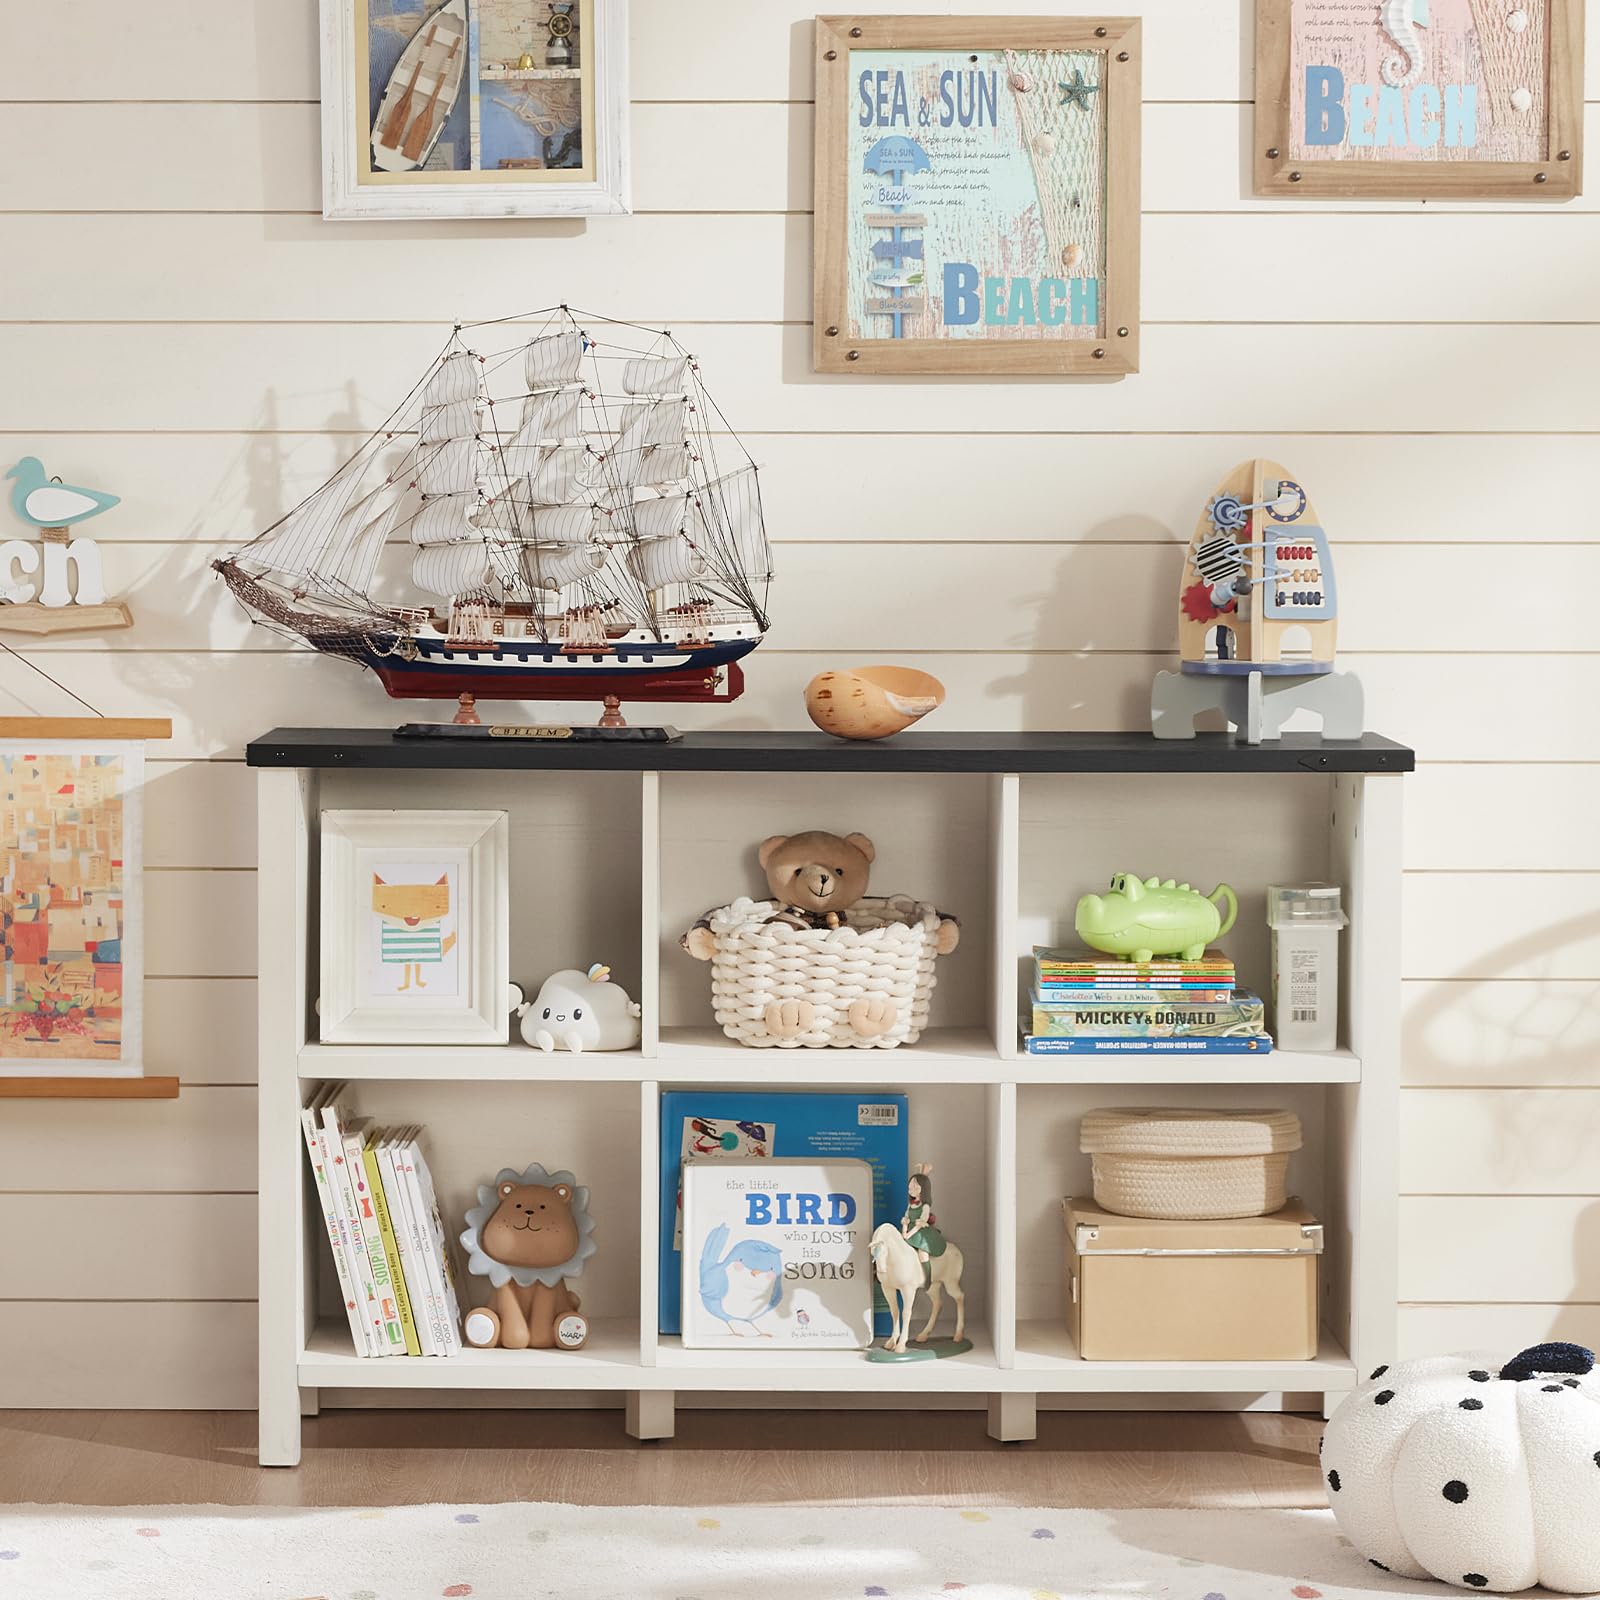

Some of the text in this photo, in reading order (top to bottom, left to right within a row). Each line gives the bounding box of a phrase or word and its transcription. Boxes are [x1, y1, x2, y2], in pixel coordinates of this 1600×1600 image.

[859, 69, 997, 128] SEA & SUN
[1304, 64, 1477, 147] BEACH
[880, 148, 892, 157] SEA
[899, 148, 914, 157] SUN
[879, 187, 912, 202] Beach
[943, 262, 1099, 326] BEACH
[880, 300, 912, 309] Blue Sea
[503, 727, 557, 737] BELEM
[1094, 992, 1113, 1001] Web
[1075, 1011, 1216, 1025] MICKEY & DONALD
[726, 1180, 779, 1190] the little
[745, 1193, 857, 1226] BIRD
[784, 1230, 857, 1244] who LOST
[387, 1252, 397, 1268] Bunny
[802, 1248, 821, 1258] his
[391, 1268, 400, 1283] Easter
[397, 1293, 405, 1306] Catch
[401, 1313, 409, 1323] How
[432, 1321, 443, 1342] DOJO
[441, 1323, 452, 1343] DOJO
